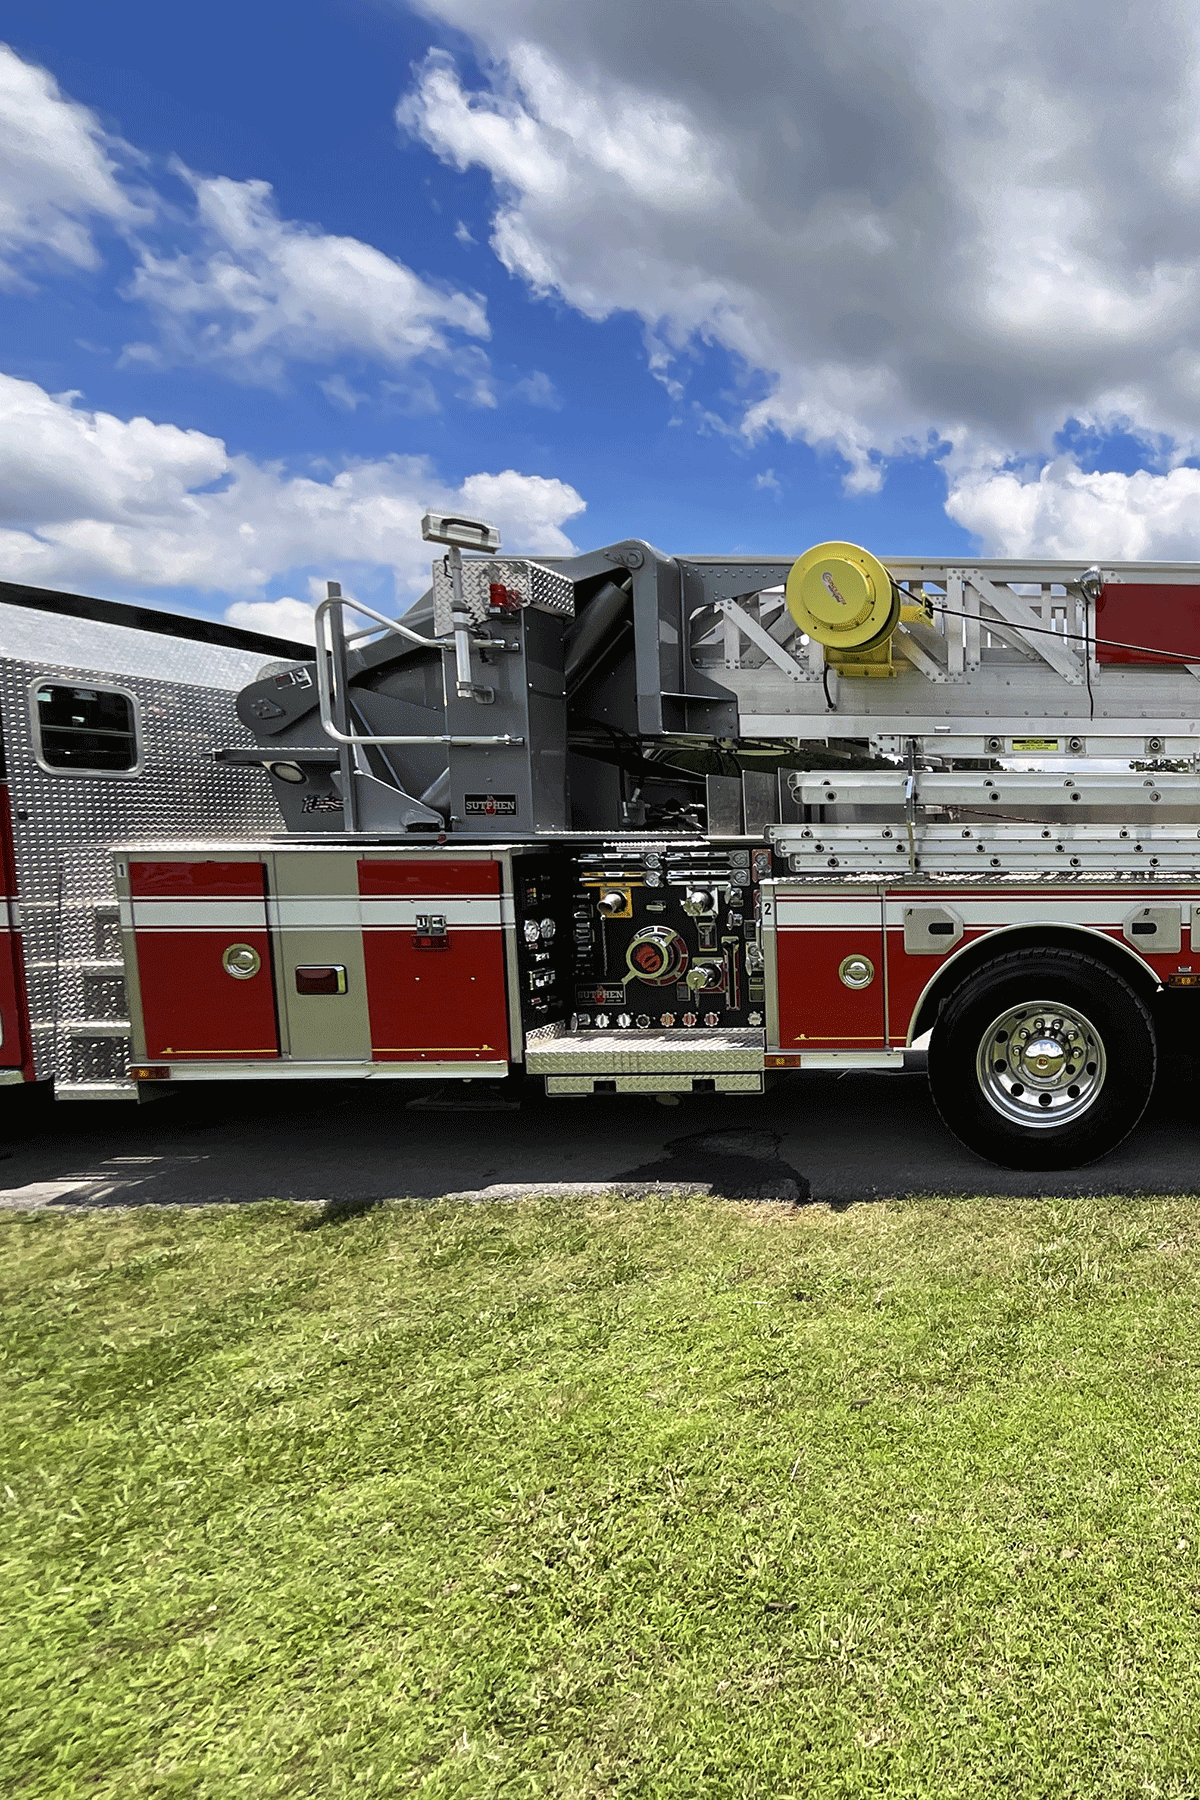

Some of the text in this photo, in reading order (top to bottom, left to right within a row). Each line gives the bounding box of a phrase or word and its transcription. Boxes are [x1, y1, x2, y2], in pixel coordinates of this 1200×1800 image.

[466, 801, 515, 810] SUTPHEN
[764, 902, 772, 915] 2
[907, 908, 913, 916] A
[1143, 908, 1150, 916] B
[577, 990, 624, 999] SUTPHEN
